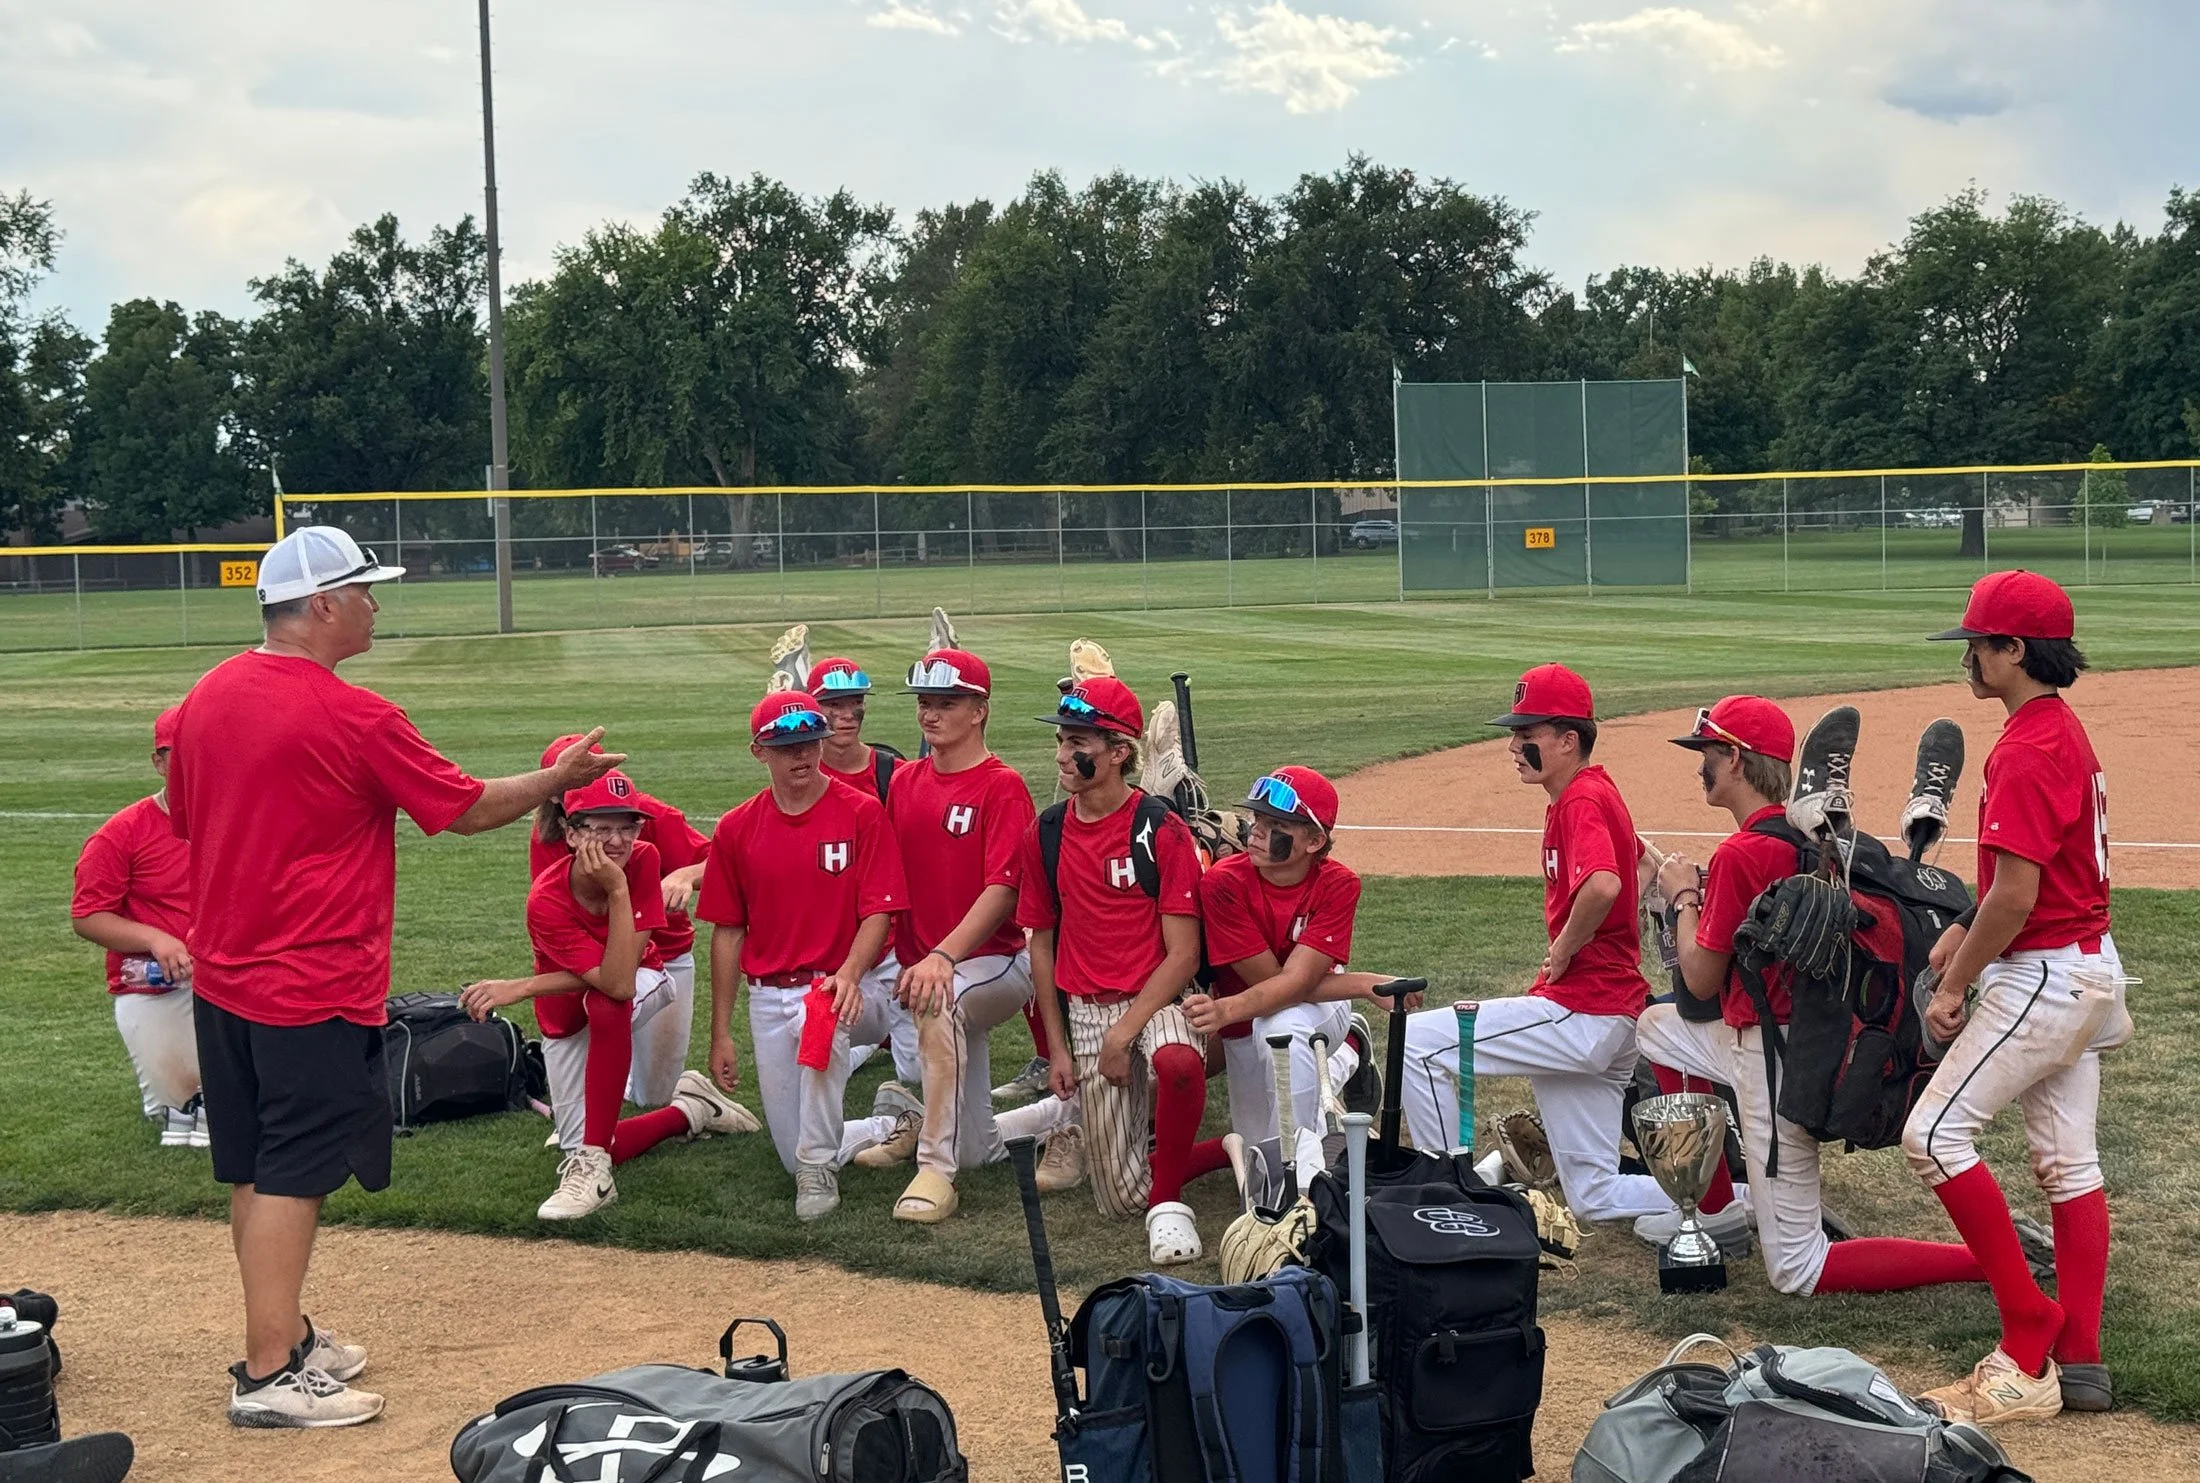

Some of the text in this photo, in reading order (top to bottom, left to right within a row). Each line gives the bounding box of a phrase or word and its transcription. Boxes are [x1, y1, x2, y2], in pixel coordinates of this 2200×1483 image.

[1529, 532, 1550, 544] 378
[226, 566, 252, 580] 352
[947, 805, 973, 835] H
[824, 842, 848, 874] H
[1110, 857, 1137, 889] H
[1545, 849, 1558, 880] H
